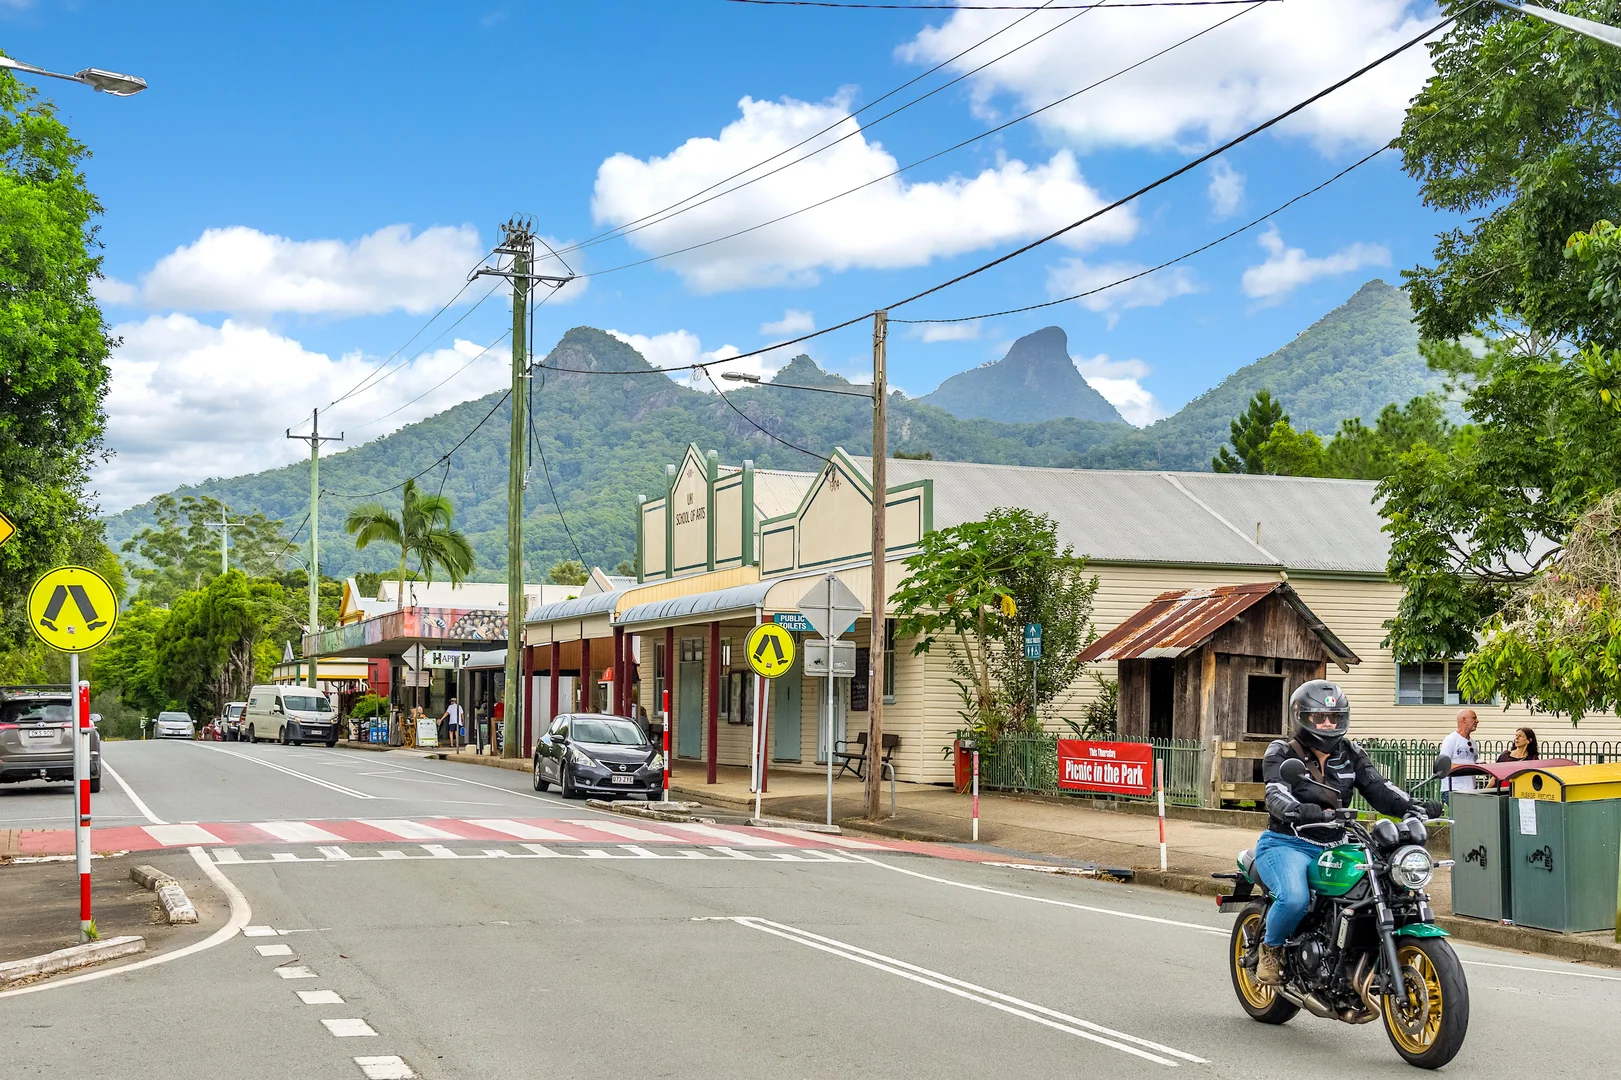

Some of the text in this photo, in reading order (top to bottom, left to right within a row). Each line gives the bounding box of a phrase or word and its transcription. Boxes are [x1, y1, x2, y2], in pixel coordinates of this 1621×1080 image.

[676, 506, 705, 525] SCHOOL OF ARTS
[780, 614, 805, 622] PUBLIC
[779, 622, 807, 630] TOILETS
[1089, 747, 1116, 759] This Thursday
[1065, 760, 1143, 786] Picnic in the Park
[1520, 791, 1555, 801] PLEASE RECYCLE
